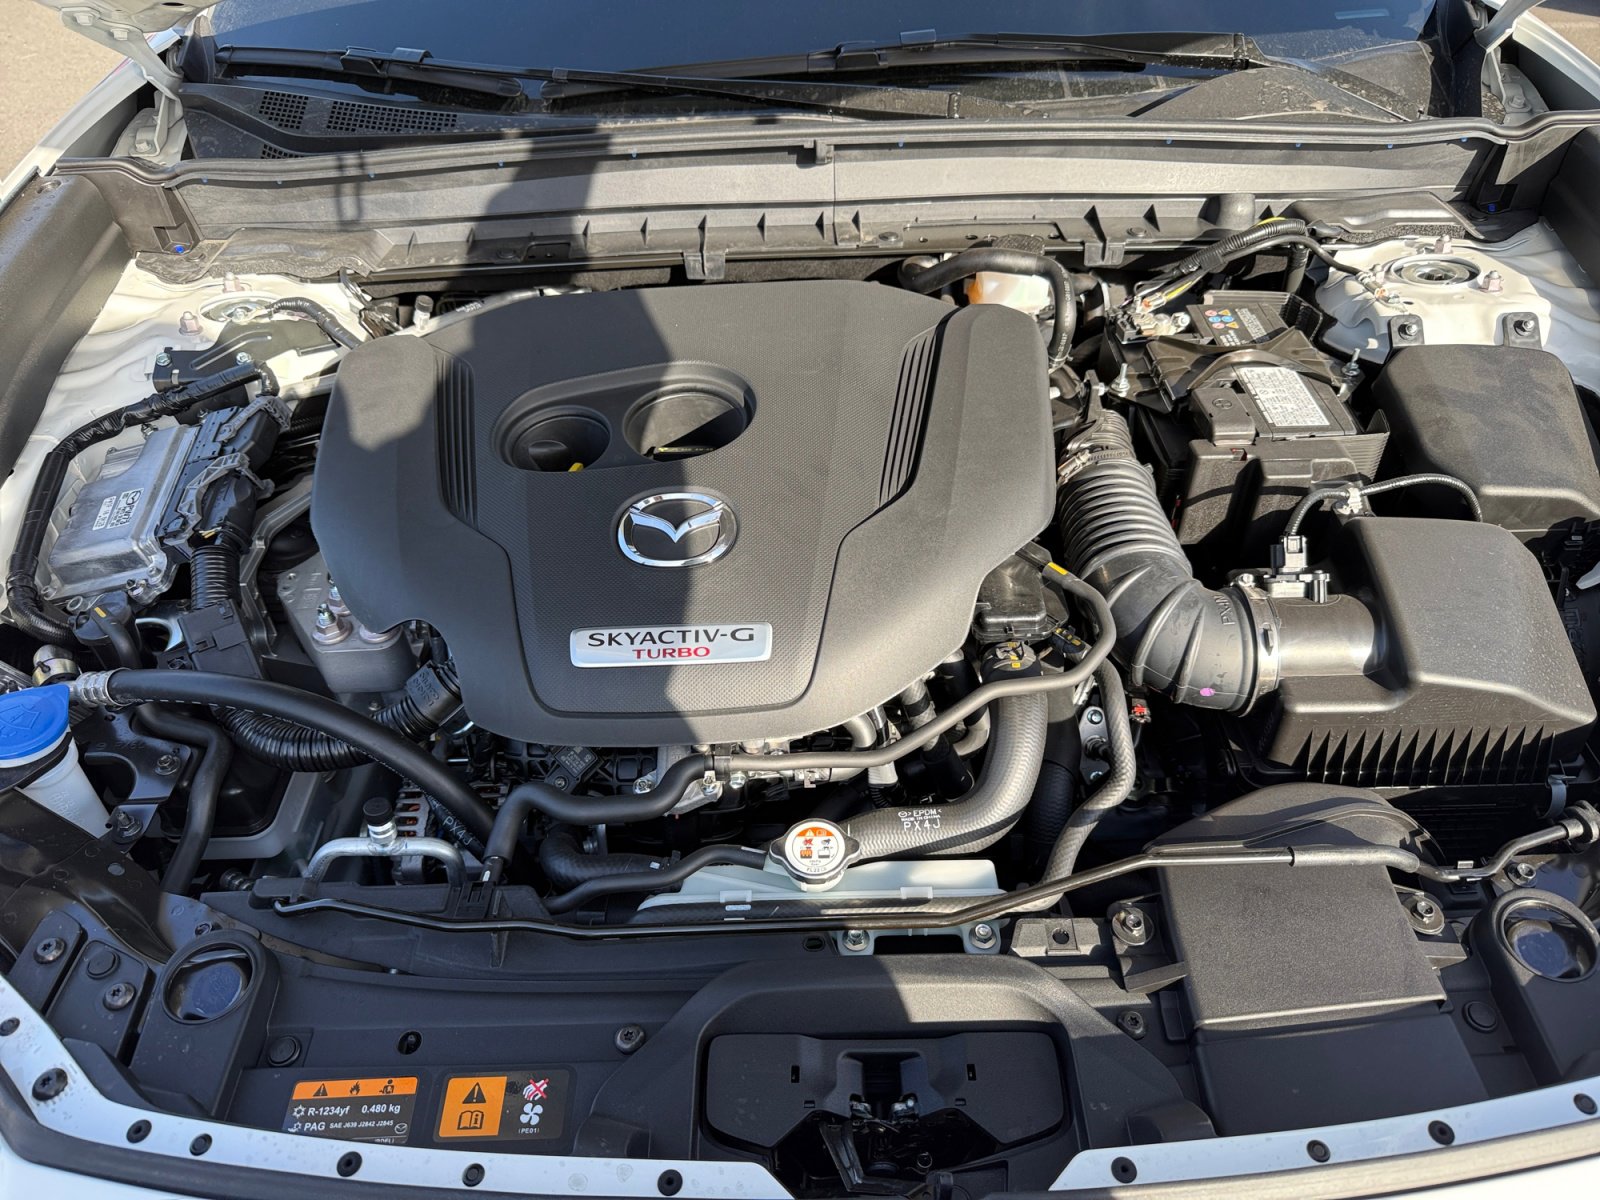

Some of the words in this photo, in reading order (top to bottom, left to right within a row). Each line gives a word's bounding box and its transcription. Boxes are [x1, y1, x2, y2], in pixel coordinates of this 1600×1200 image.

[587, 627, 754, 647] SKYACTIV-G
[632, 646, 710, 660] TURBO
[443, 816, 473, 845] PX4J
[903, 818, 941, 832] PX4J
[307, 1105, 351, 1118] R-1234yf
[361, 1103, 387, 1114] 0.480
[389, 1103, 401, 1115] kg
[303, 1122, 326, 1132] PAG
[343, 1121, 357, 1129] J639
[358, 1120, 376, 1128] J2842
[376, 1119, 394, 1127] J2845
